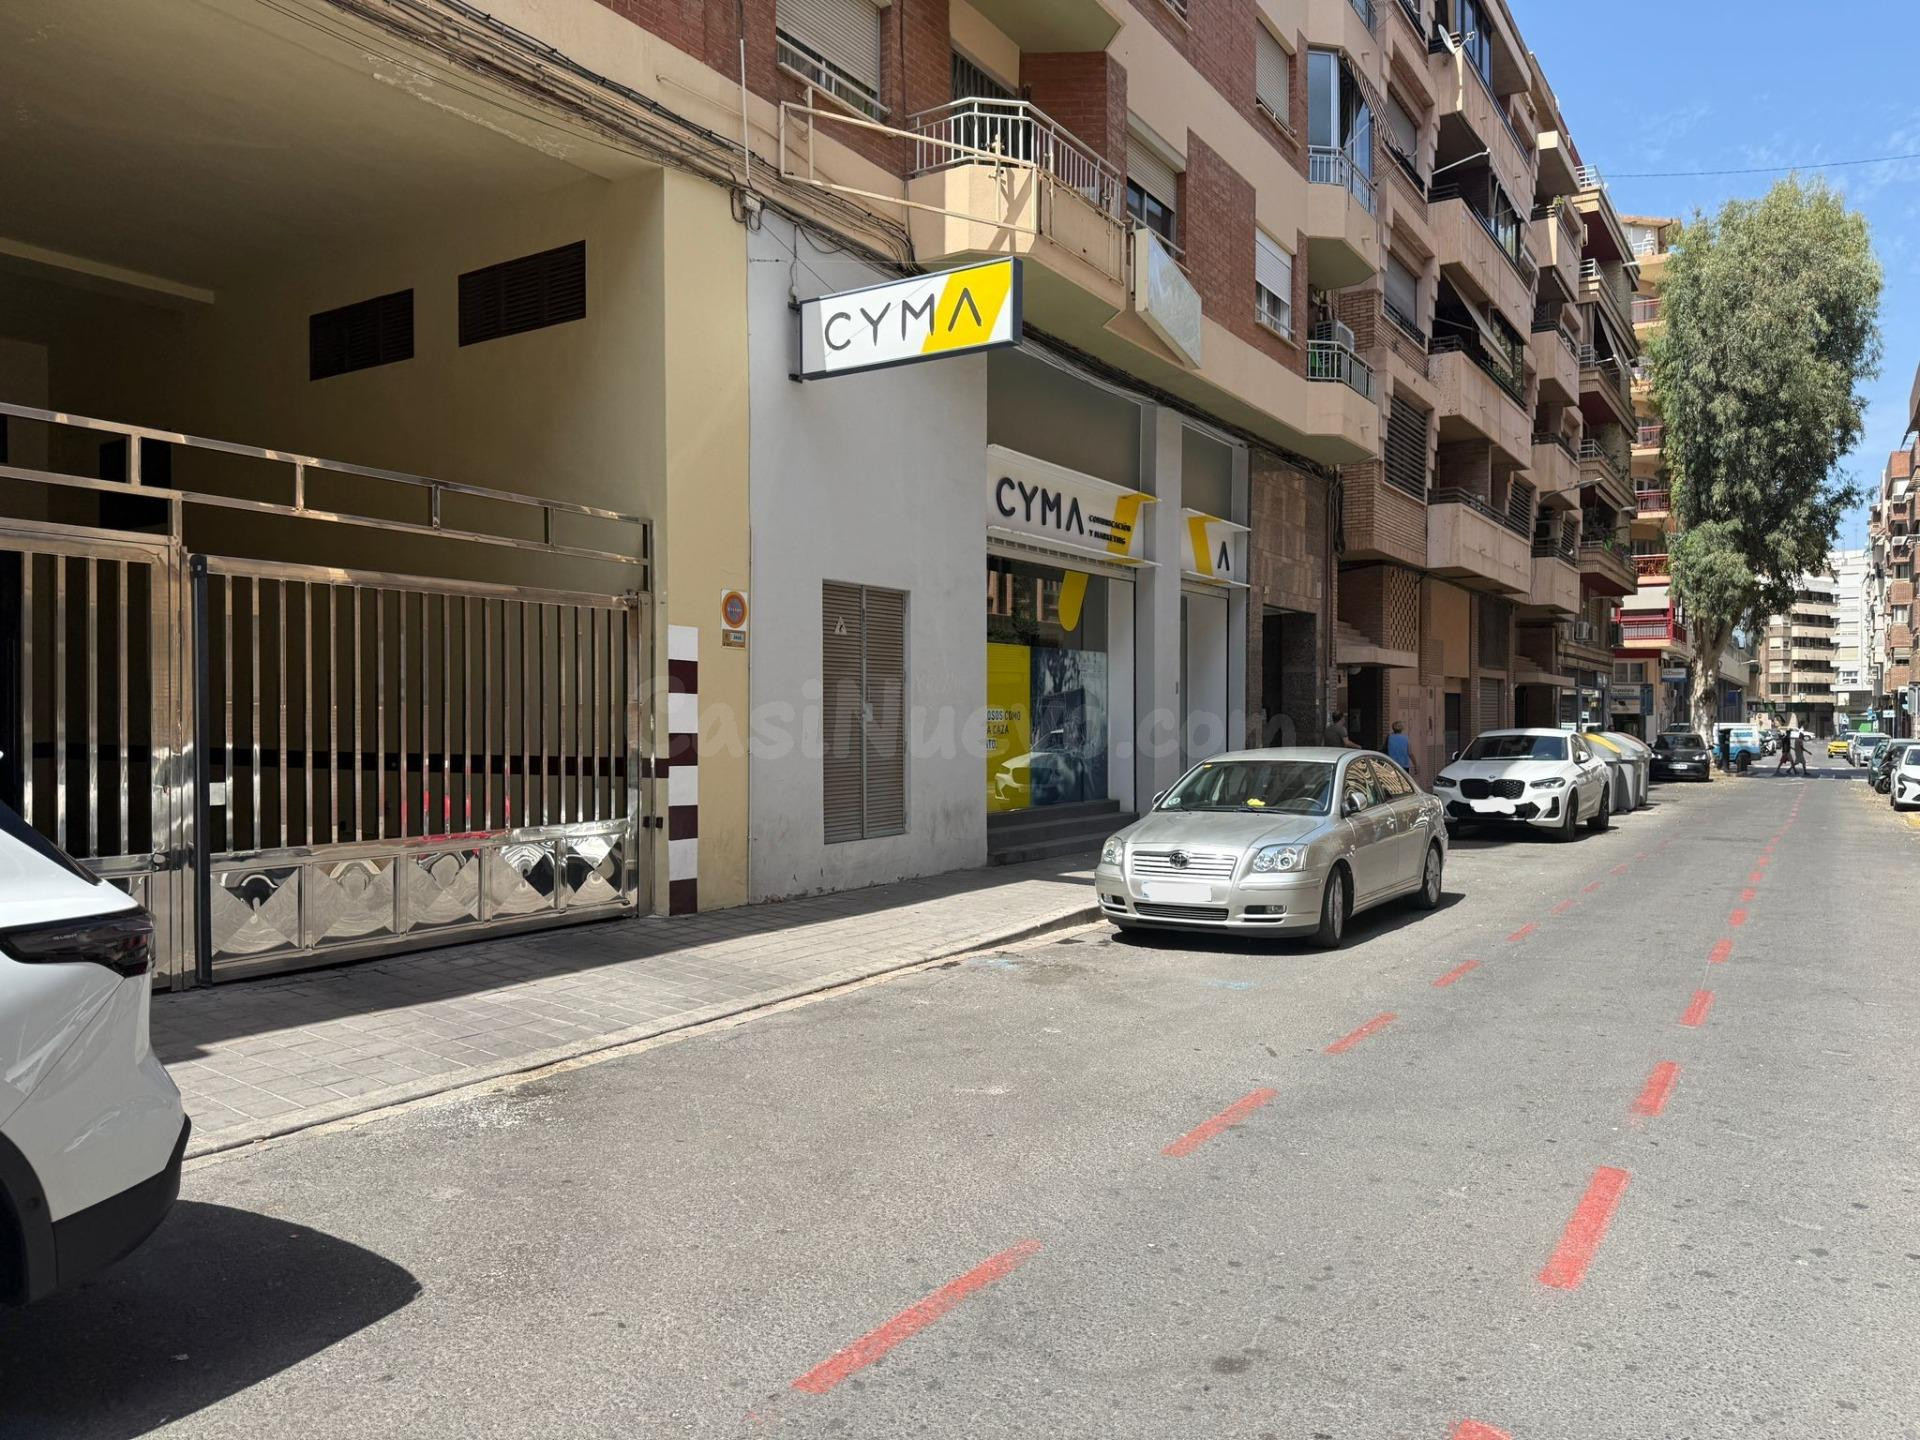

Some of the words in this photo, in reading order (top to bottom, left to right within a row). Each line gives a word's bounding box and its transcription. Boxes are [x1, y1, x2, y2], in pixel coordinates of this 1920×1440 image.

[824, 287, 982, 351] CYMA
[995, 476, 1085, 536] CYMA
[1004, 710, 1021, 721] COMO
